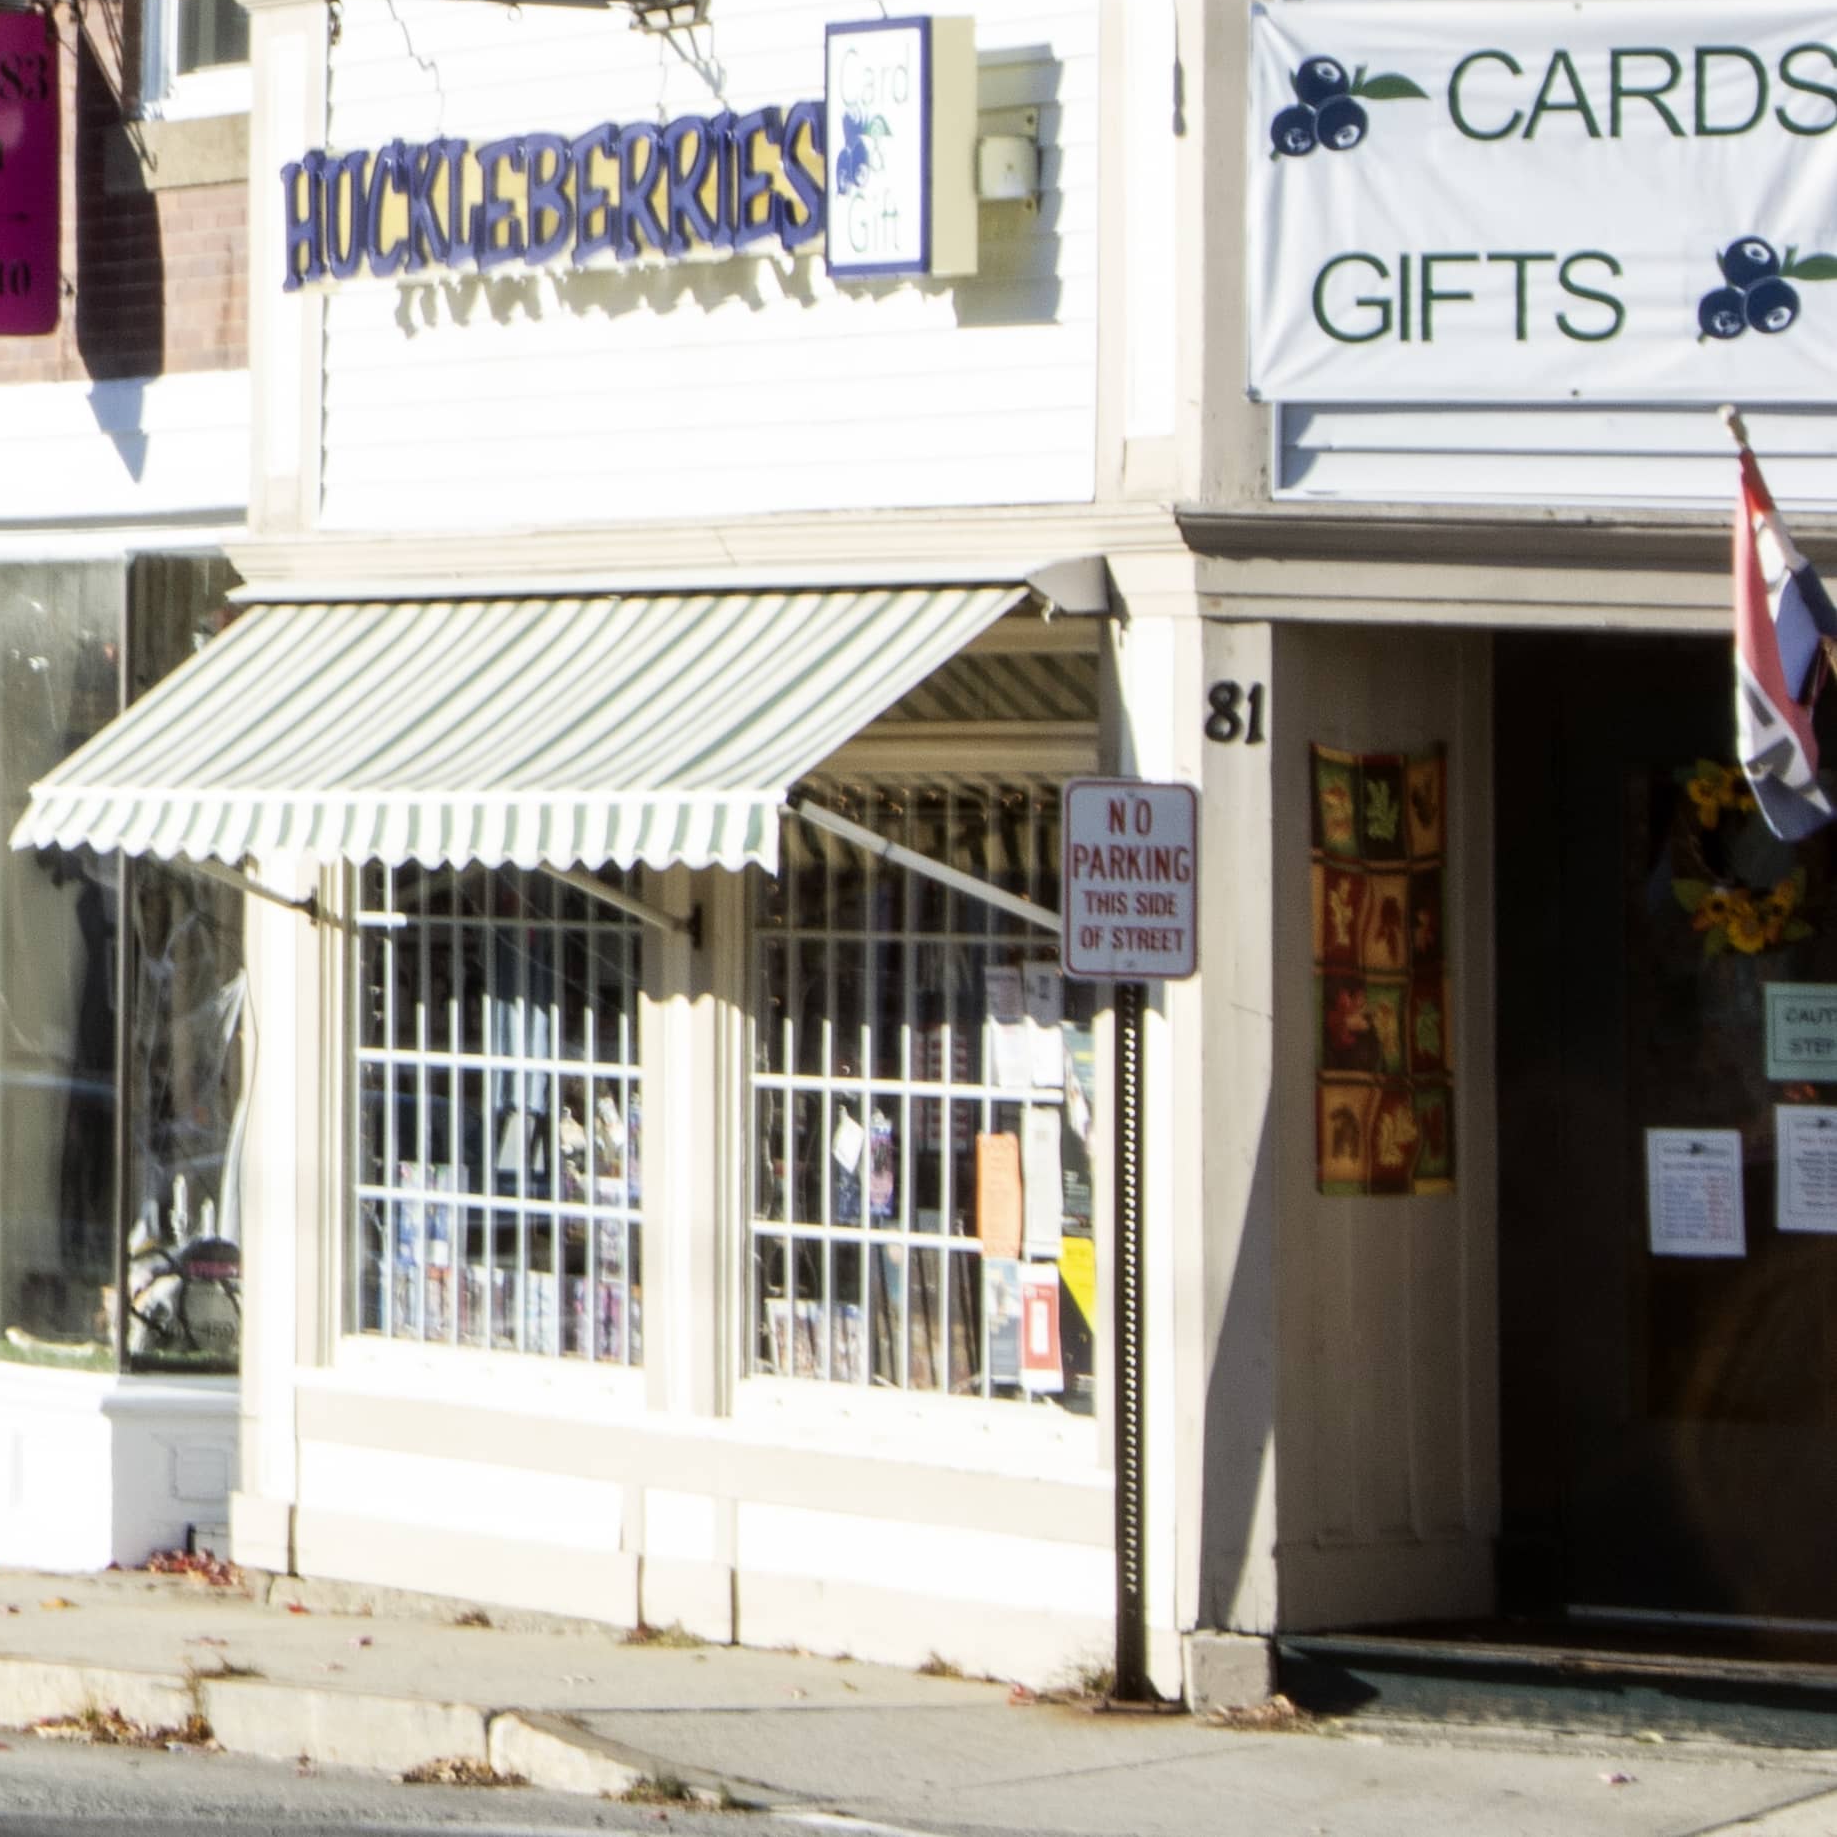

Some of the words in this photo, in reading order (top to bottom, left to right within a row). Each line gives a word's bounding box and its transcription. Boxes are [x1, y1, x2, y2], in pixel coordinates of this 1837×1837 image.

[840, 42, 910, 108] Card
[1448, 43, 1837, 142] CARDS
[280, 101, 826, 293] HUCKLEBERRIES
[848, 187, 902, 253] Gift
[1311, 250, 1626, 343] GIFTS
[1204, 678, 1266, 746] 81
[1108, 797, 1153, 837] NO
[1072, 844, 1192, 884] PARKING
[1084, 890, 1128, 918] THIS
[1135, 892, 1178, 919] SIDE
[1080, 926, 1104, 953] OF
[1112, 926, 1185, 954] STREET
